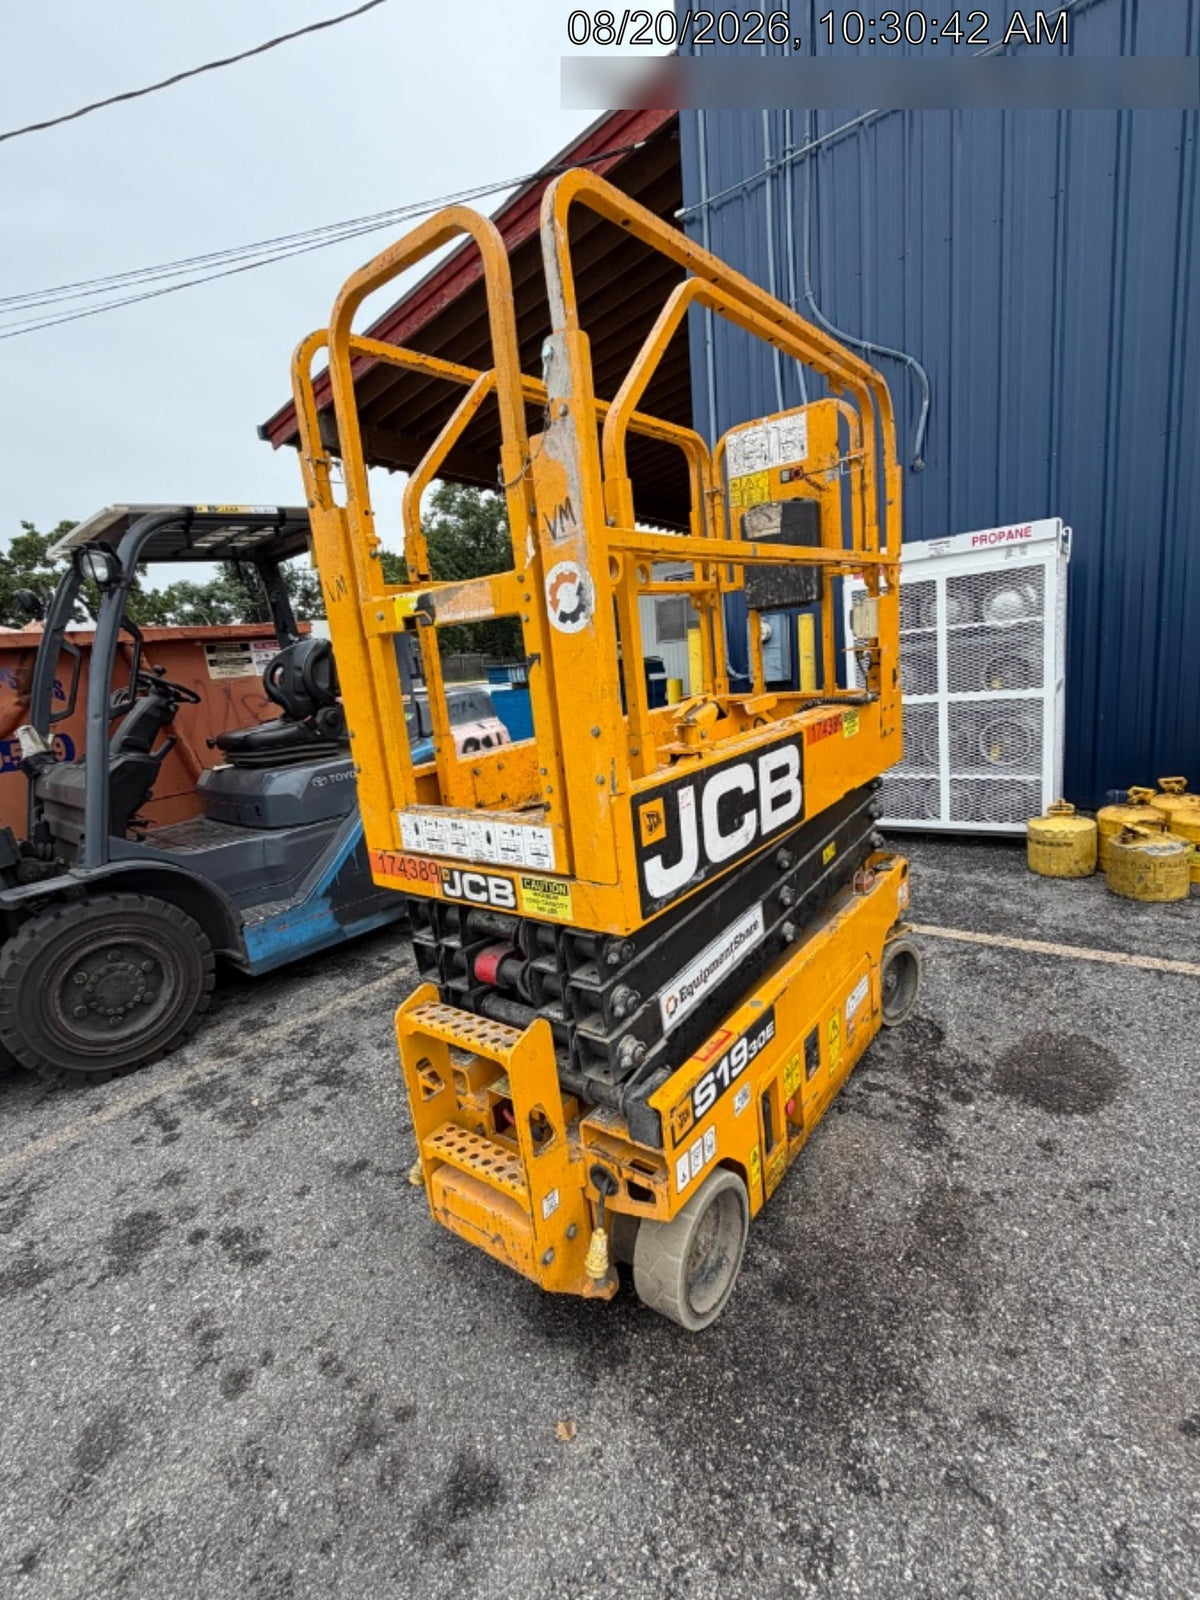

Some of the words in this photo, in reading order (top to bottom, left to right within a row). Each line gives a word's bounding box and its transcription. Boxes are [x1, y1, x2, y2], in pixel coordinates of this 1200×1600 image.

[543, 496, 577, 540] VM
[971, 526, 1033, 547] PROPANE
[643, 744, 803, 899] JCB
[378, 852, 440, 883] 174389
[443, 870, 516, 908] JCB
[523, 879, 568, 896] CAUTION
